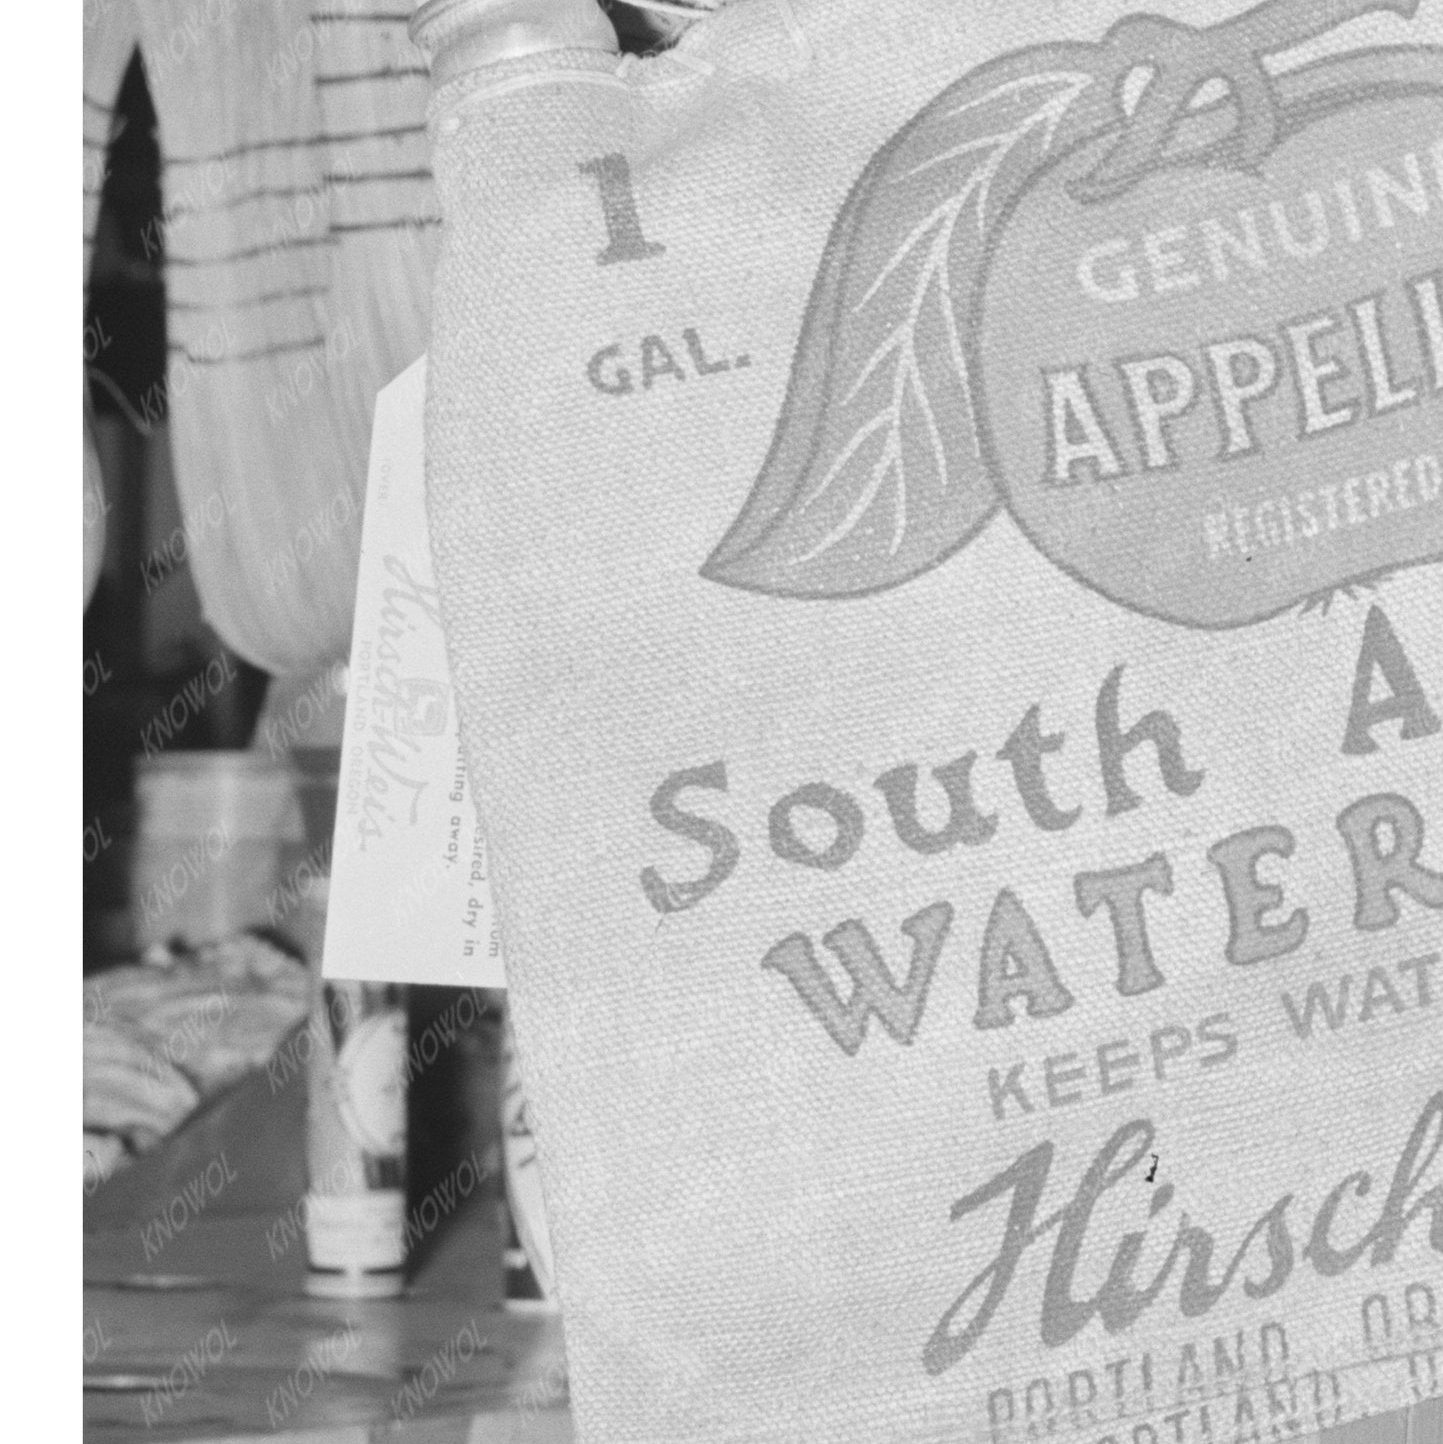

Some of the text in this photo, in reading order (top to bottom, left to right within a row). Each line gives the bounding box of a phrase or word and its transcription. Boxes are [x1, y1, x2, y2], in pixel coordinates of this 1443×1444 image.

[578, 150, 667, 267] 1
[585, 322, 754, 397] GAL.
[1204, 454, 1443, 564] REGISTERED
[449, 732, 467, 803] utting
[639, 664, 1204, 915] South
[462, 816, 488, 958] esired, dry in
[984, 1010, 1241, 1123] KEEPS
